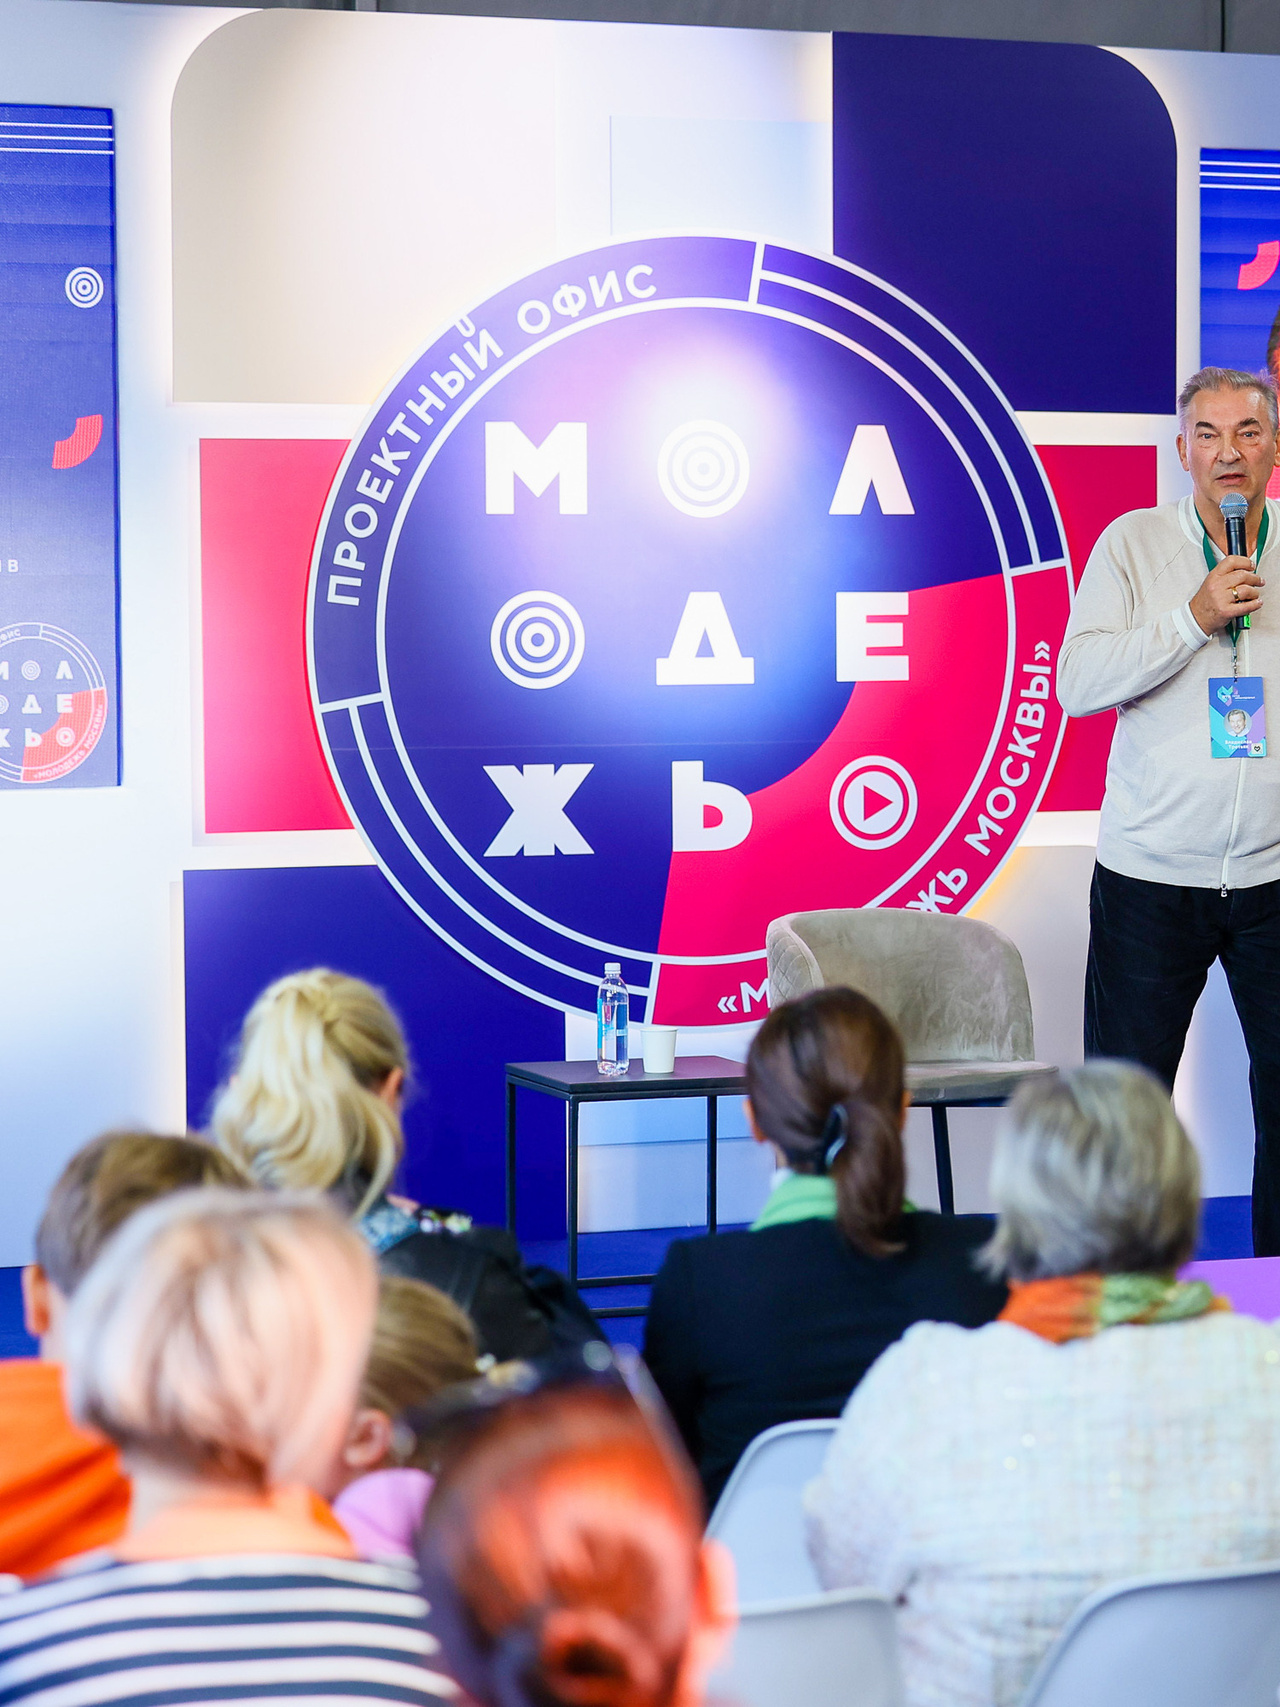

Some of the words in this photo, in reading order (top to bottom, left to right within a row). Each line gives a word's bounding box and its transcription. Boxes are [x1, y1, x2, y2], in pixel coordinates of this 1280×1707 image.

[327, 313, 504, 606] ПРОЕКТНЫЙ
[517, 264, 657, 334] ОФИС
[964, 640, 1052, 857] МОСКВЫ»
